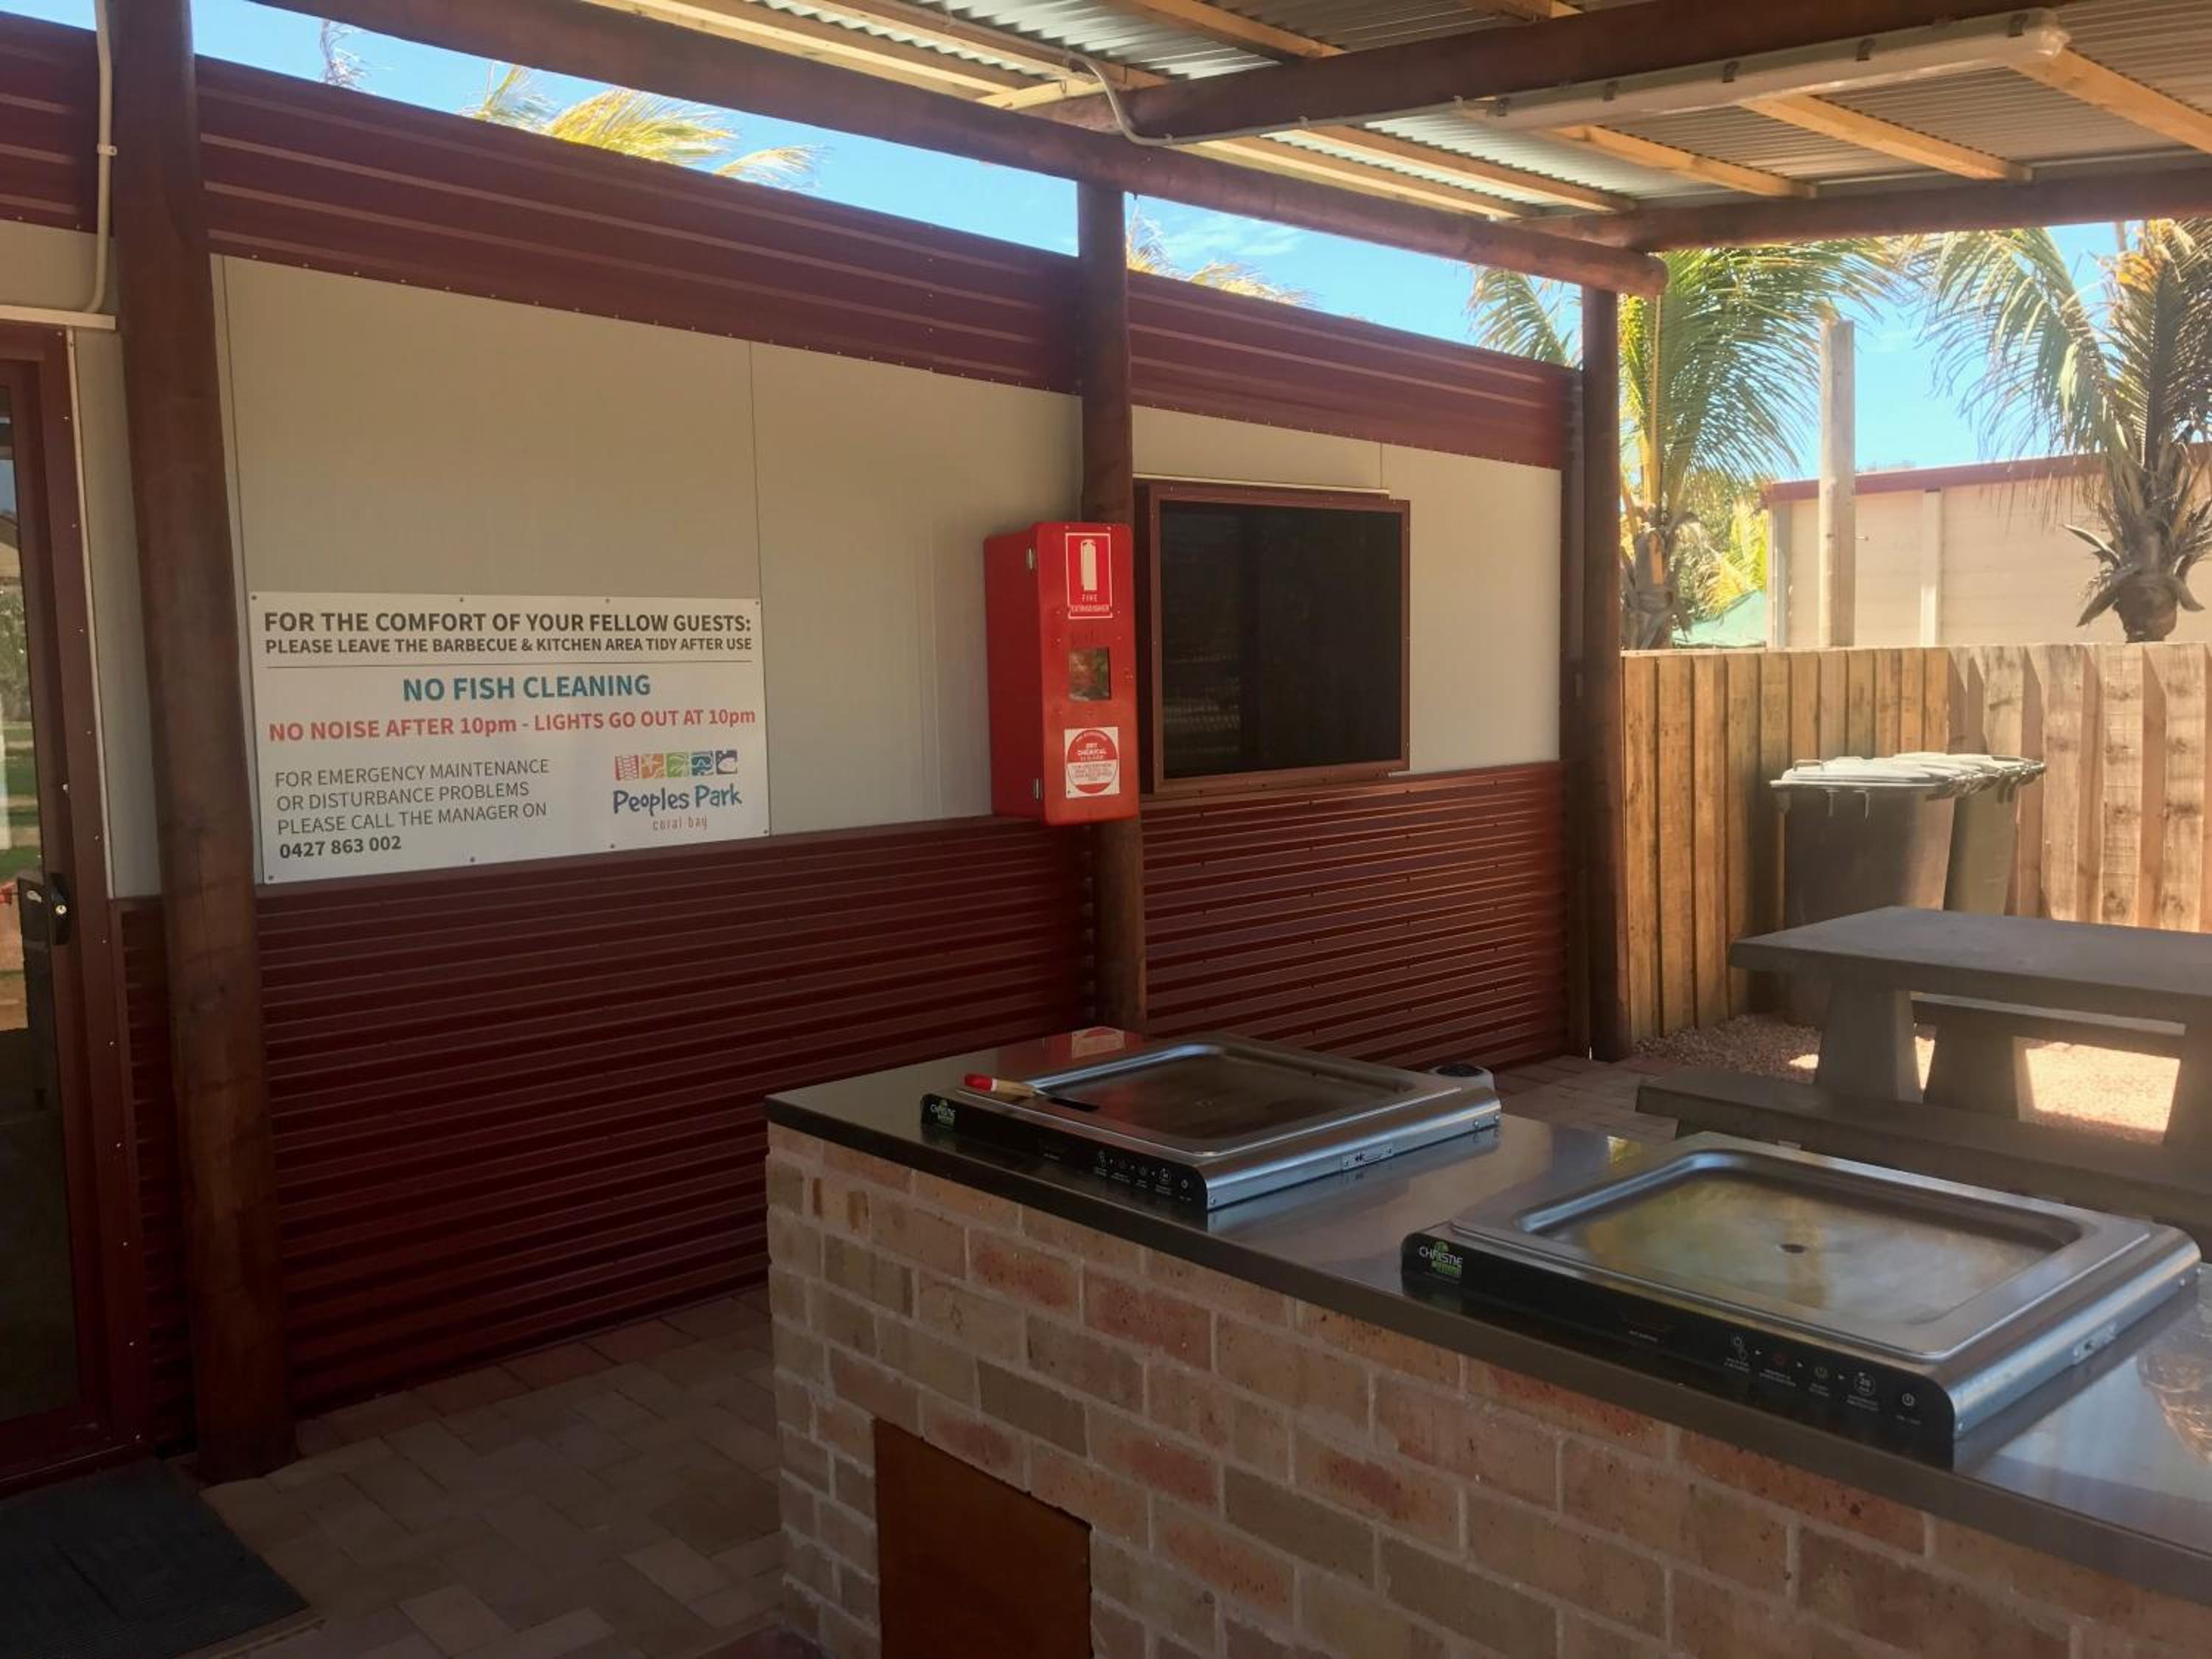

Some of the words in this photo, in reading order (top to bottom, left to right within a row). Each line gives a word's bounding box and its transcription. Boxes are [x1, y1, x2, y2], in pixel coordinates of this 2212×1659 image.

[265, 612, 313, 632] FOR
[321, 613, 369, 632] THE
[376, 613, 487, 632] COMFORT
[493, 613, 521, 632] OF
[526, 613, 583, 632] YOUR
[590, 614, 667, 632] FELLOW
[673, 615, 751, 632] GUESTS:
[265, 639, 333, 654] PLEASE
[338, 639, 390, 653] LEAVE
[394, 639, 428, 653] THE
[433, 638, 517, 653] BARBECUE
[521, 638, 533, 652] &
[537, 638, 602, 651] KITCHEN
[605, 639, 643, 651] AREA
[646, 639, 678, 650] TIDY
[681, 639, 723, 650] AFTER
[726, 639, 752, 650] USE
[403, 678, 445, 701] NO
[453, 677, 515, 700] FISH
[524, 674, 650, 698] CLEANING
[269, 723, 304, 742] NO
[311, 720, 380, 740] NOISE
[386, 717, 453, 737] AFTER
[461, 716, 517, 737] 10pm
[535, 712, 603, 731] LIGHTS
[608, 712, 635, 728] GO
[640, 710, 678, 728] OUT
[684, 709, 703, 725] AT
[709, 709, 756, 728] 10pm
[276, 770, 312, 787] FOR
[318, 765, 425, 786] EMERGENCY
[431, 759, 549, 780] MAINTENANCE
[276, 794, 304, 812] OR
[309, 787, 434, 810] DISTURBANCE
[439, 782, 529, 801] PROBLEMS
[613, 787, 689, 816] Peoples
[695, 783, 742, 808] Park
[278, 815, 345, 835] PLEASE
[352, 813, 394, 830] CALL
[399, 810, 433, 827] THE
[438, 804, 518, 824] MANAGER
[524, 802, 547, 818] ON
[688, 815, 708, 830] bay
[279, 841, 325, 859] 0427
[331, 838, 364, 855] 863
[369, 835, 402, 852] 002
